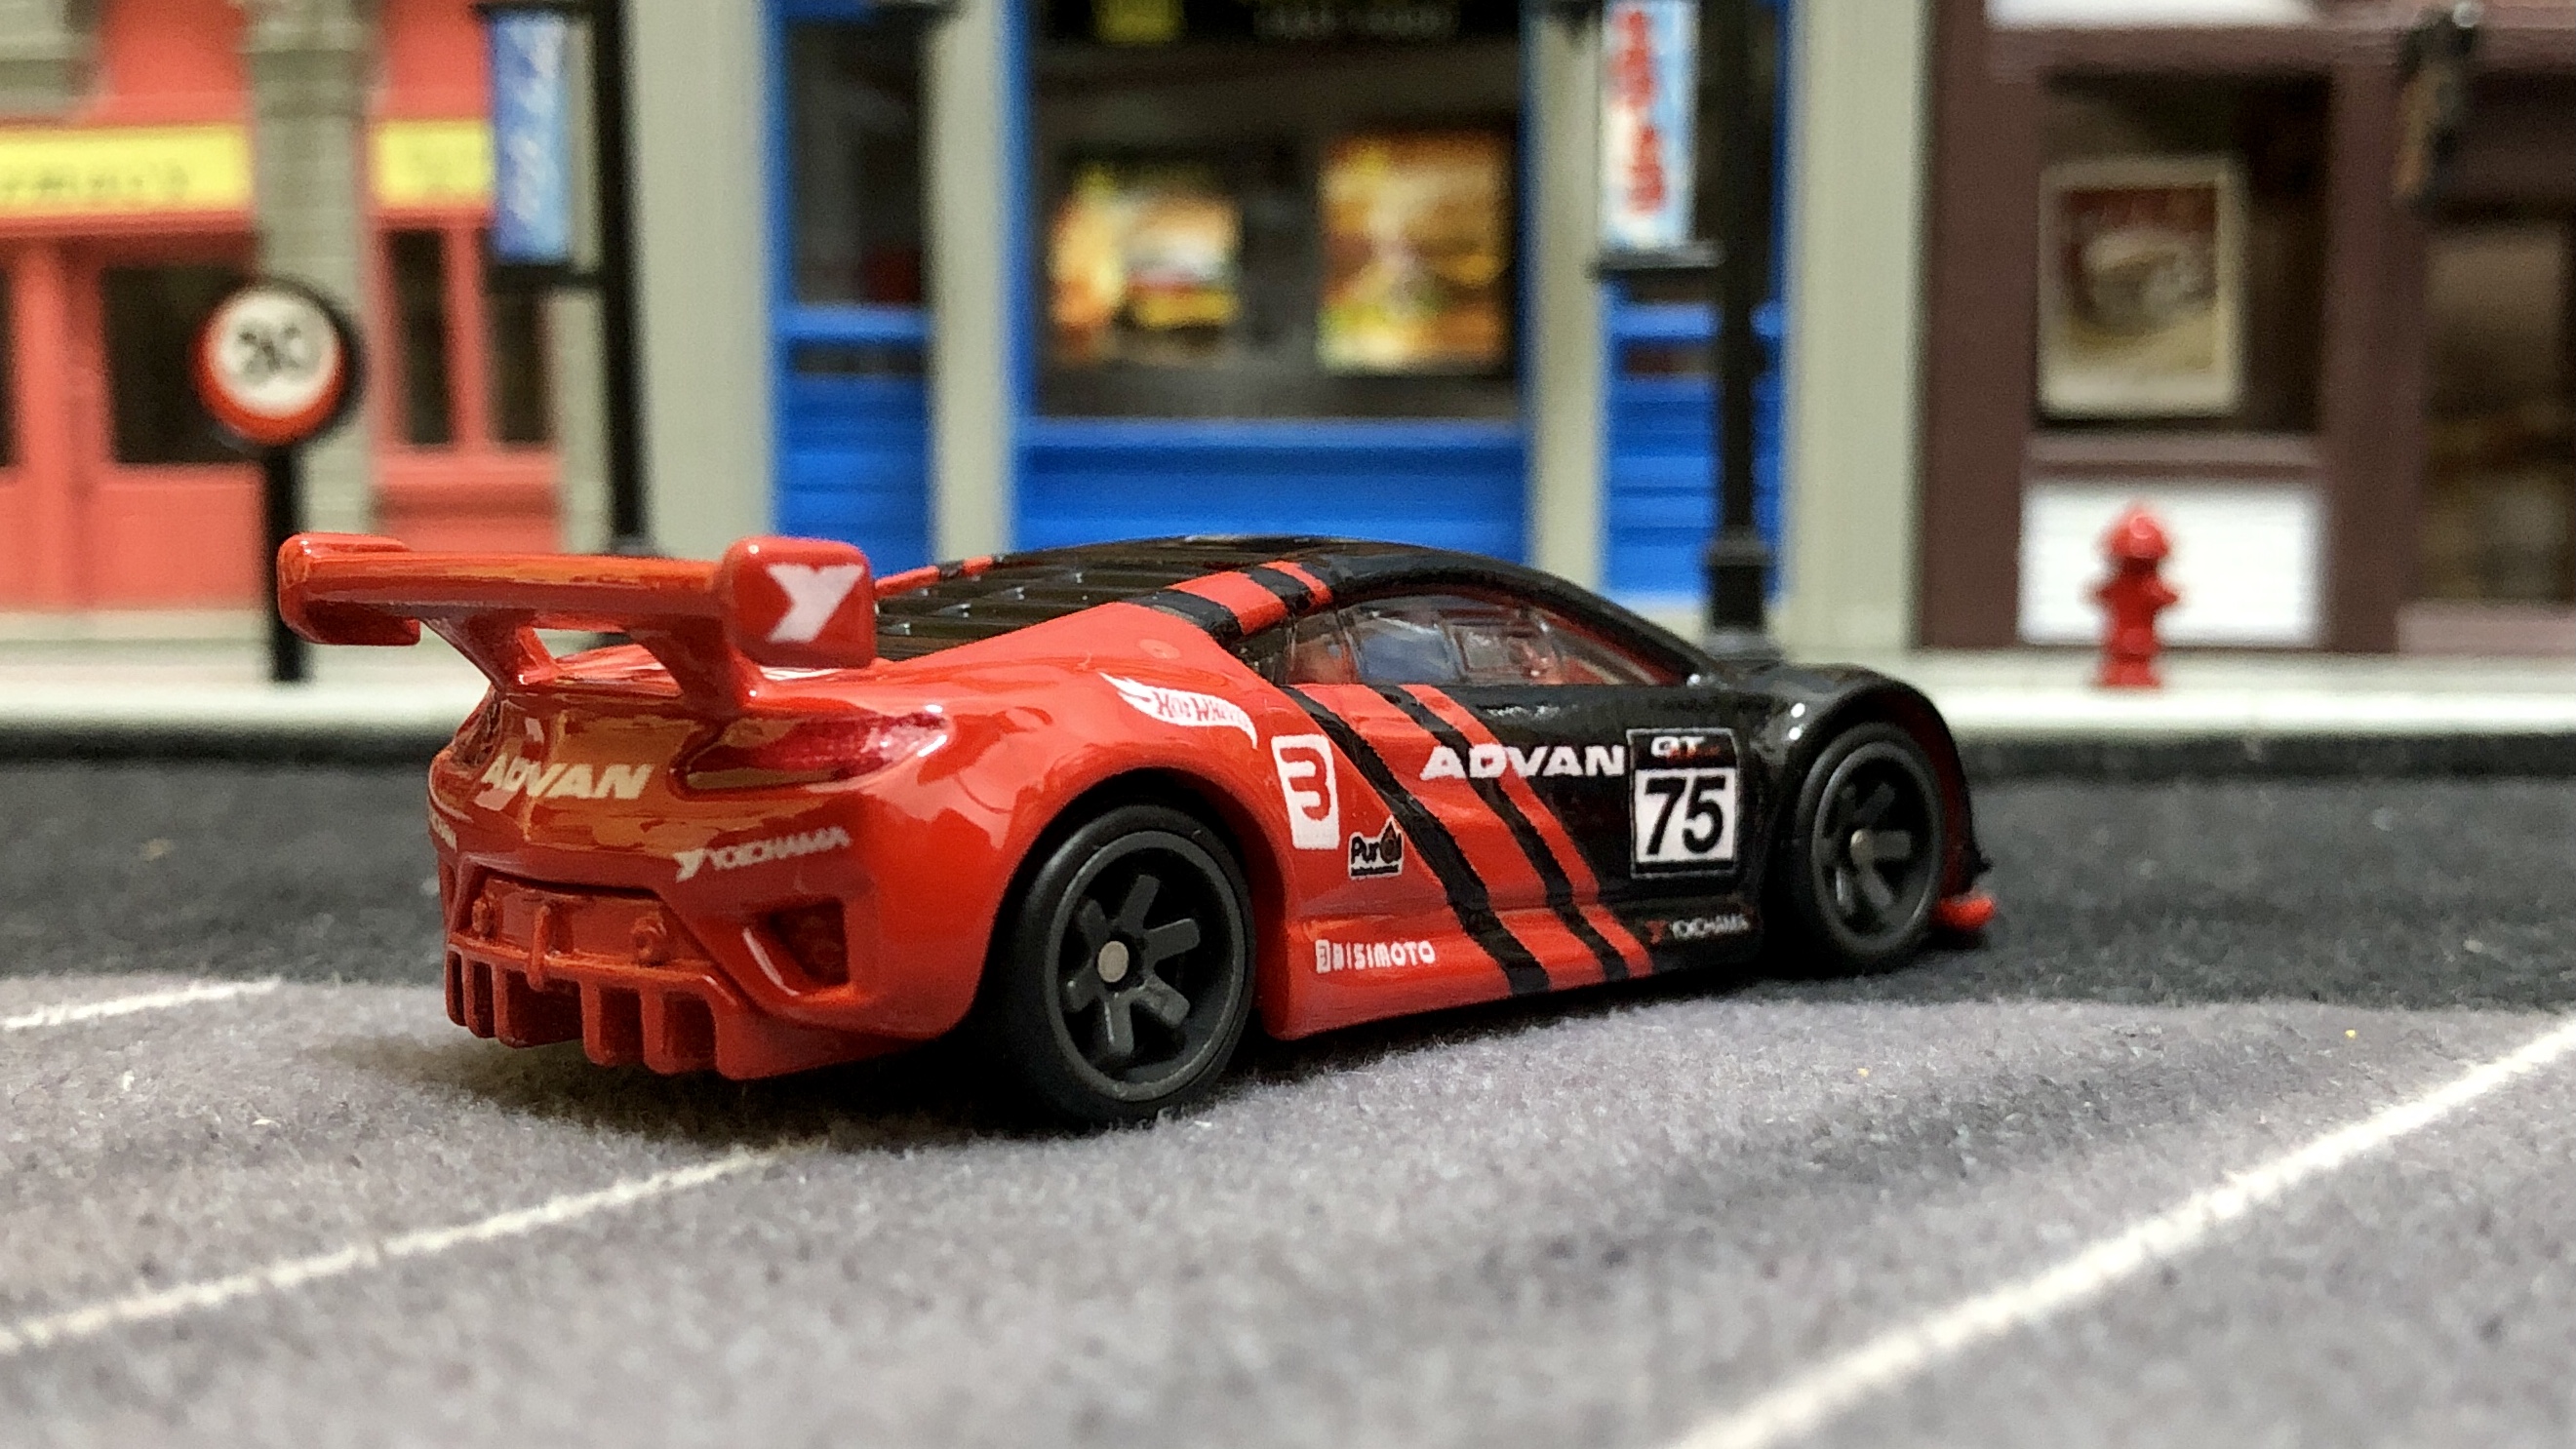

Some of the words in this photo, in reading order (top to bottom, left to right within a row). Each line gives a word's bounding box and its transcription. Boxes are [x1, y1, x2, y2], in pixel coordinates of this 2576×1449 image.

[1419, 743, 1625, 780] ADVAN
[1650, 735, 1705, 758] GT
[480, 752, 654, 800] ADVAN
[1645, 775, 1726, 855] 75
